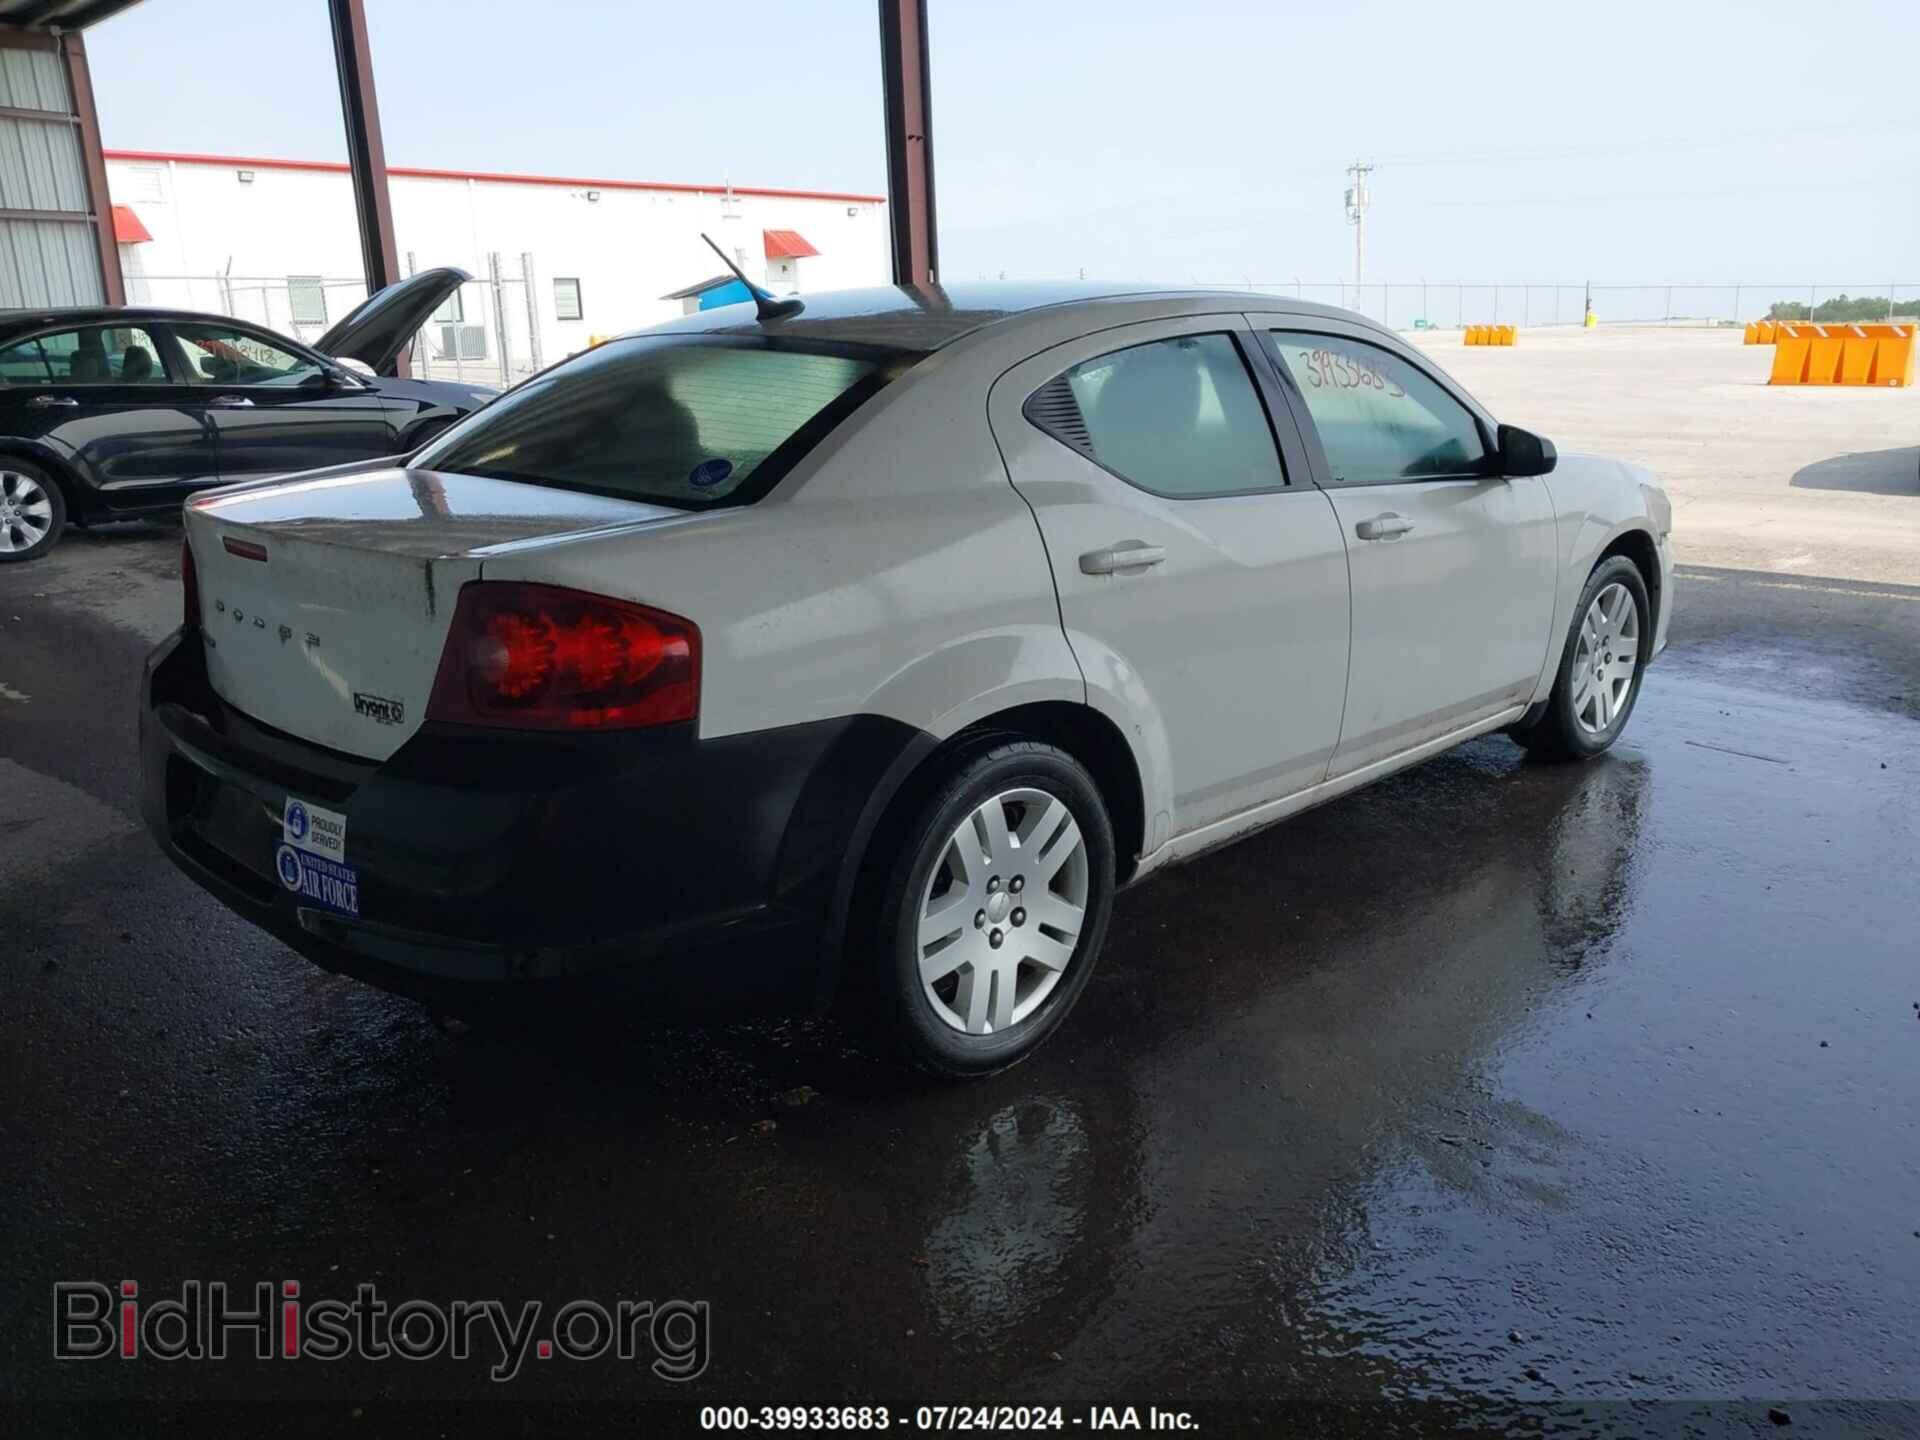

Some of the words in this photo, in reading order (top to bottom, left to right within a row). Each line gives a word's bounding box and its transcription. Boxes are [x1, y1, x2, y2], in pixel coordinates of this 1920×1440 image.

[311, 815, 343, 836] PROUDLY
[301, 853, 328, 873] UNITED
[328, 863, 357, 883] STATES
[302, 869, 321, 900] AIR
[321, 875, 359, 912] FORCE
